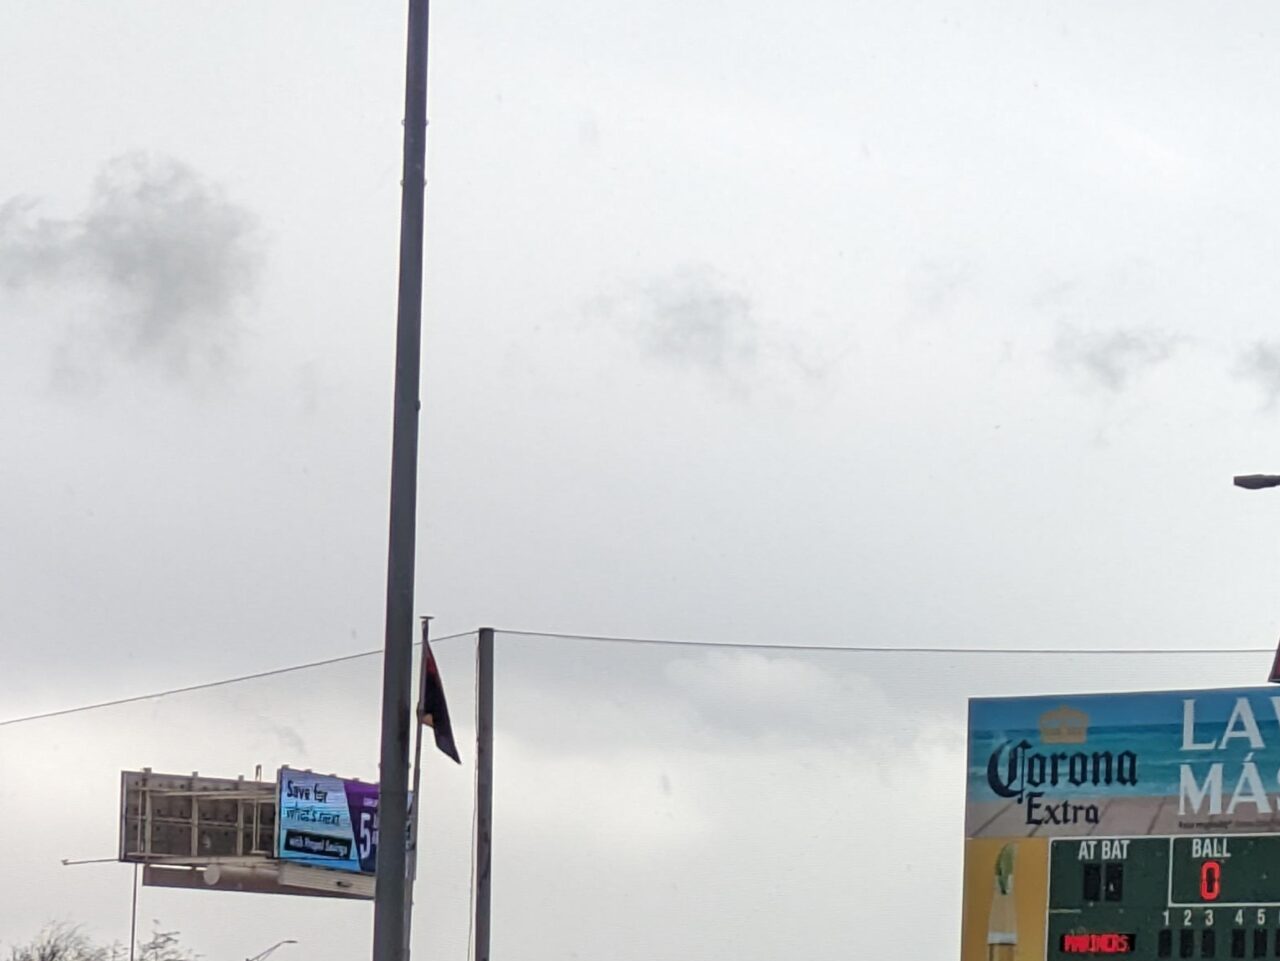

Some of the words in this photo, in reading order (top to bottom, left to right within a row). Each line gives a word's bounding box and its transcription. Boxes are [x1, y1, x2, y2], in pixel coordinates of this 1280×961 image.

[1179, 696, 1266, 750] LA
[987, 739, 1138, 804] Corona
[1025, 791, 1099, 825] Extra
[1078, 841, 1098, 860] AT
[1101, 840, 1130, 860] BAT
[1192, 838, 1231, 858] BALL
[1201, 860, 1221, 900] 0
[1163, 909, 1170, 925] 1
[1184, 909, 1192, 925] 2
[1205, 909, 1214, 925] 3
[1235, 908, 1244, 924] 4
[1257, 908, 1265, 924] 5
